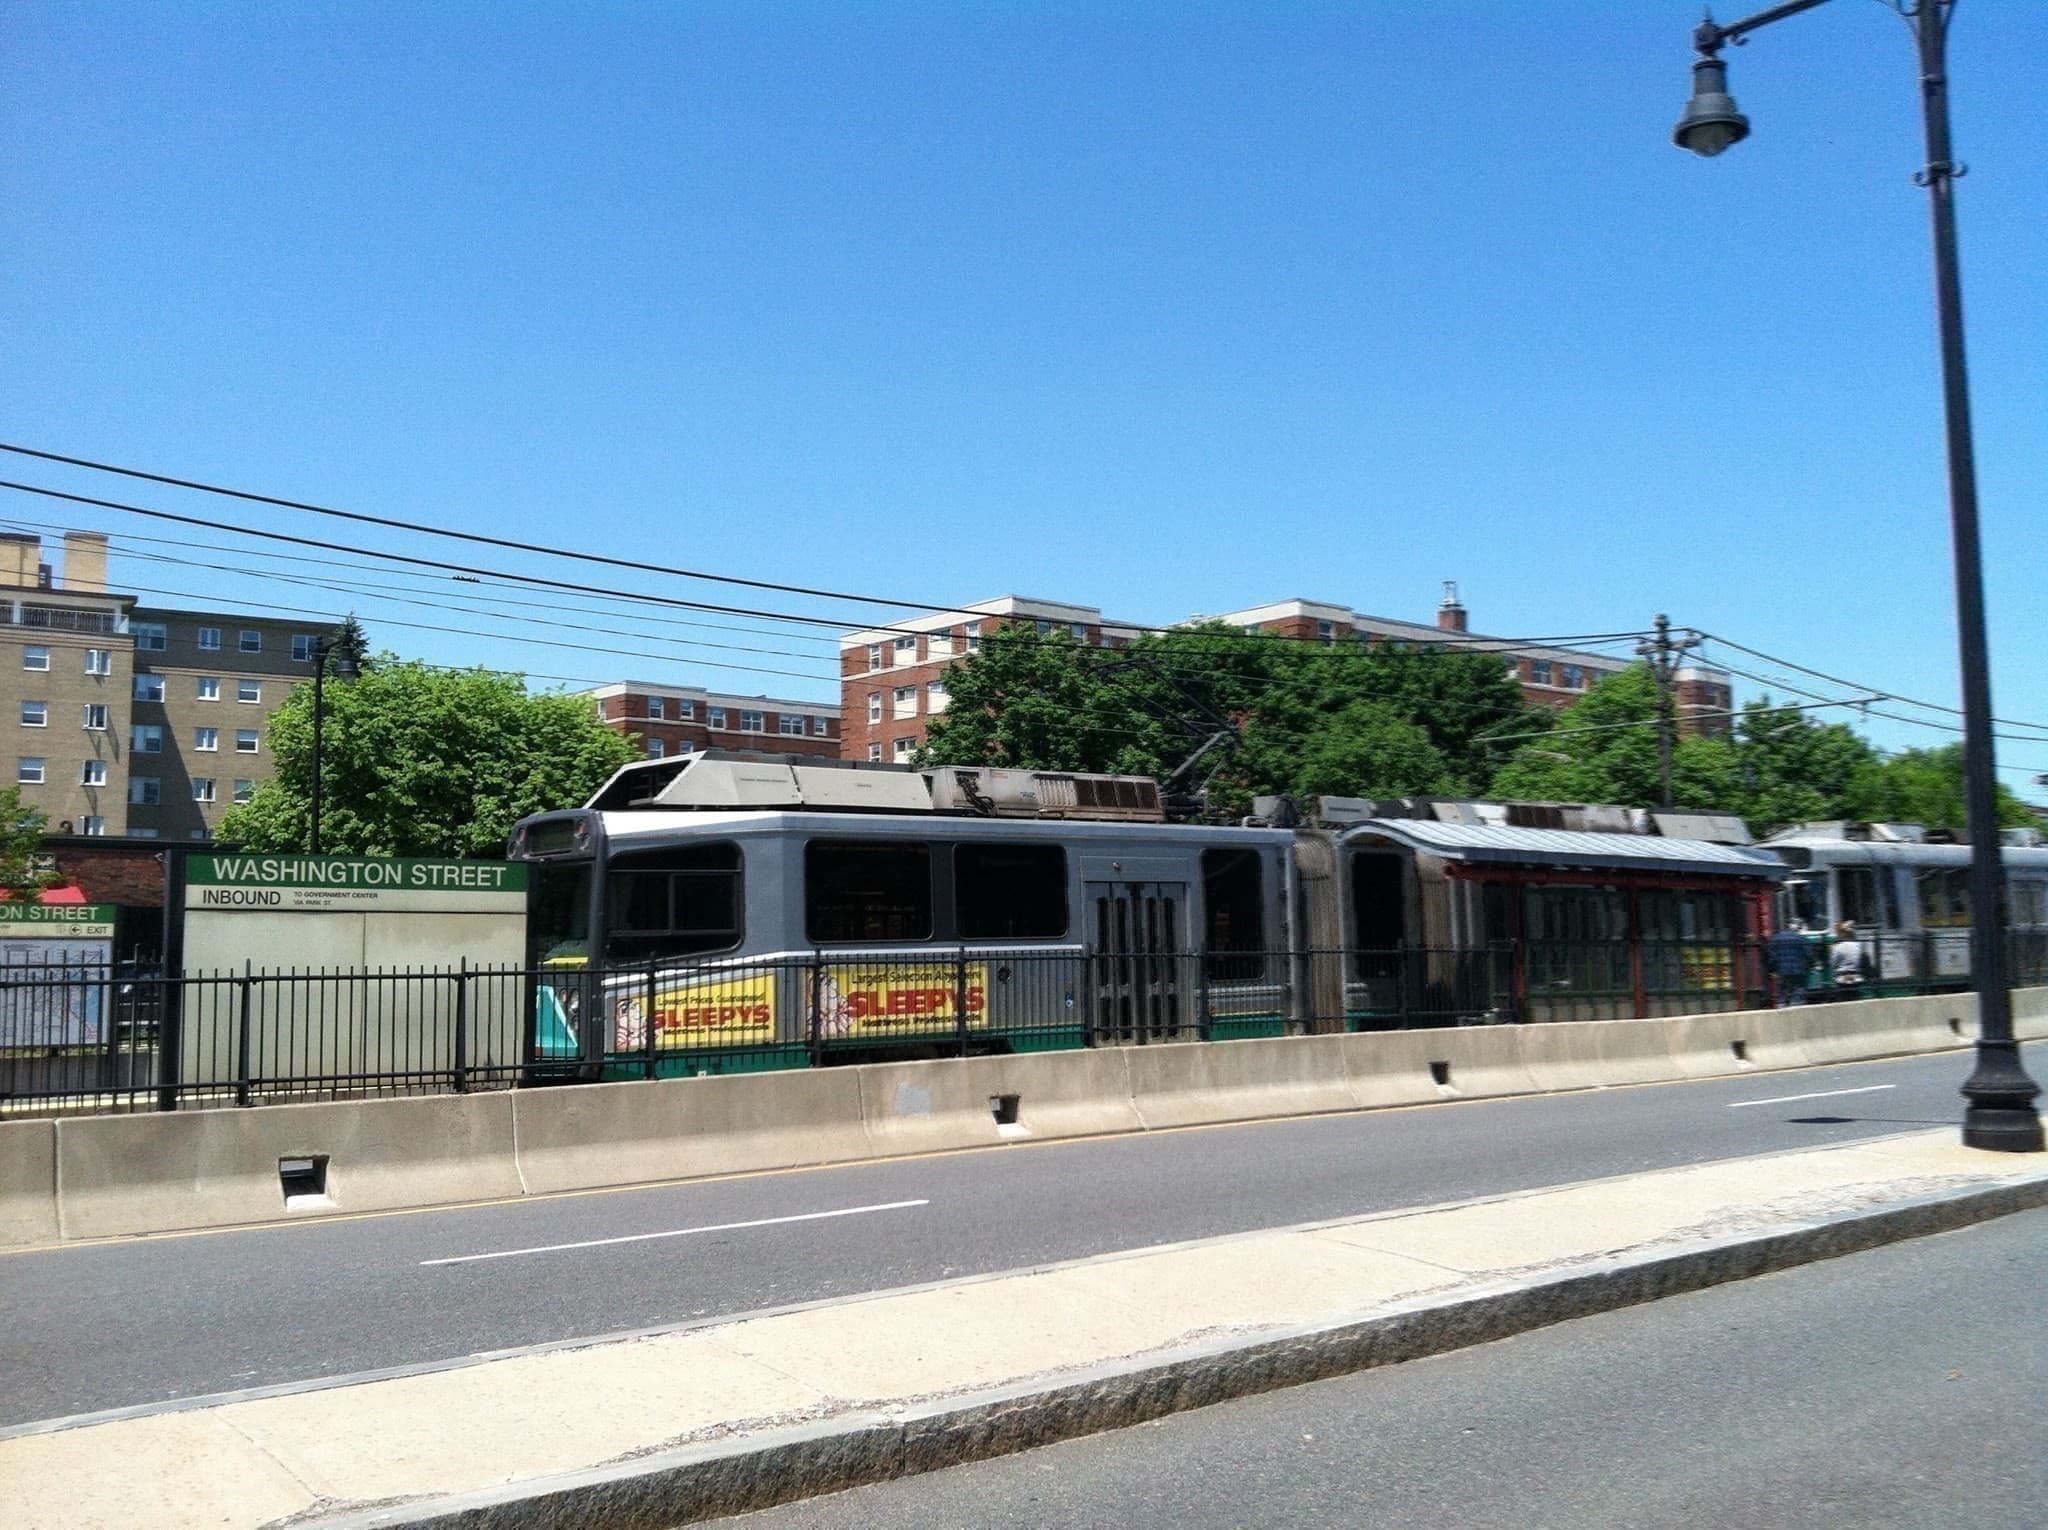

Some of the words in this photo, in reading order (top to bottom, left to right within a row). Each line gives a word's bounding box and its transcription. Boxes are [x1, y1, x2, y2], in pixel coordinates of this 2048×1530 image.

[212, 858, 402, 884] WASHINGTON
[411, 864, 507, 887] STREET
[202, 889, 281, 905] INBOUND
[29, 905, 99, 920] STREET
[86, 926, 108, 934] EXIT
[852, 970, 888, 987] Largest
[889, 967, 933, 982] Selection
